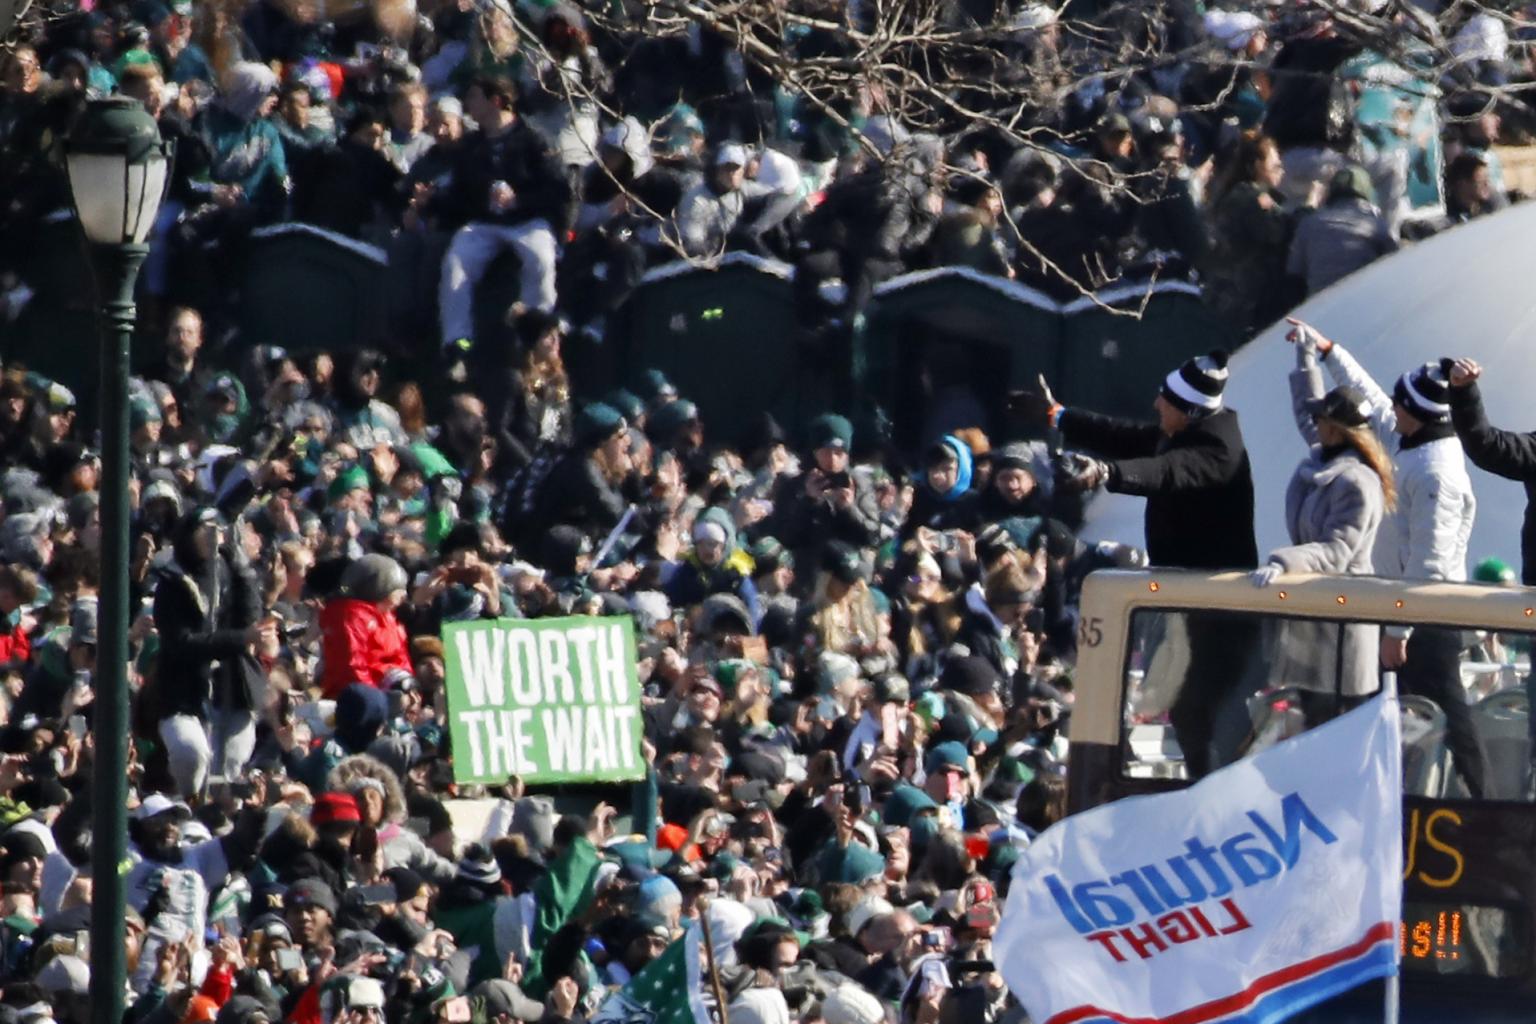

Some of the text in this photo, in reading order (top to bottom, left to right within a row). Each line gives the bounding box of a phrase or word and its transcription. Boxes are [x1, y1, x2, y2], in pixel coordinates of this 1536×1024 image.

[455, 624, 629, 706] WORTH
[459, 704, 635, 777] THE WAIT
